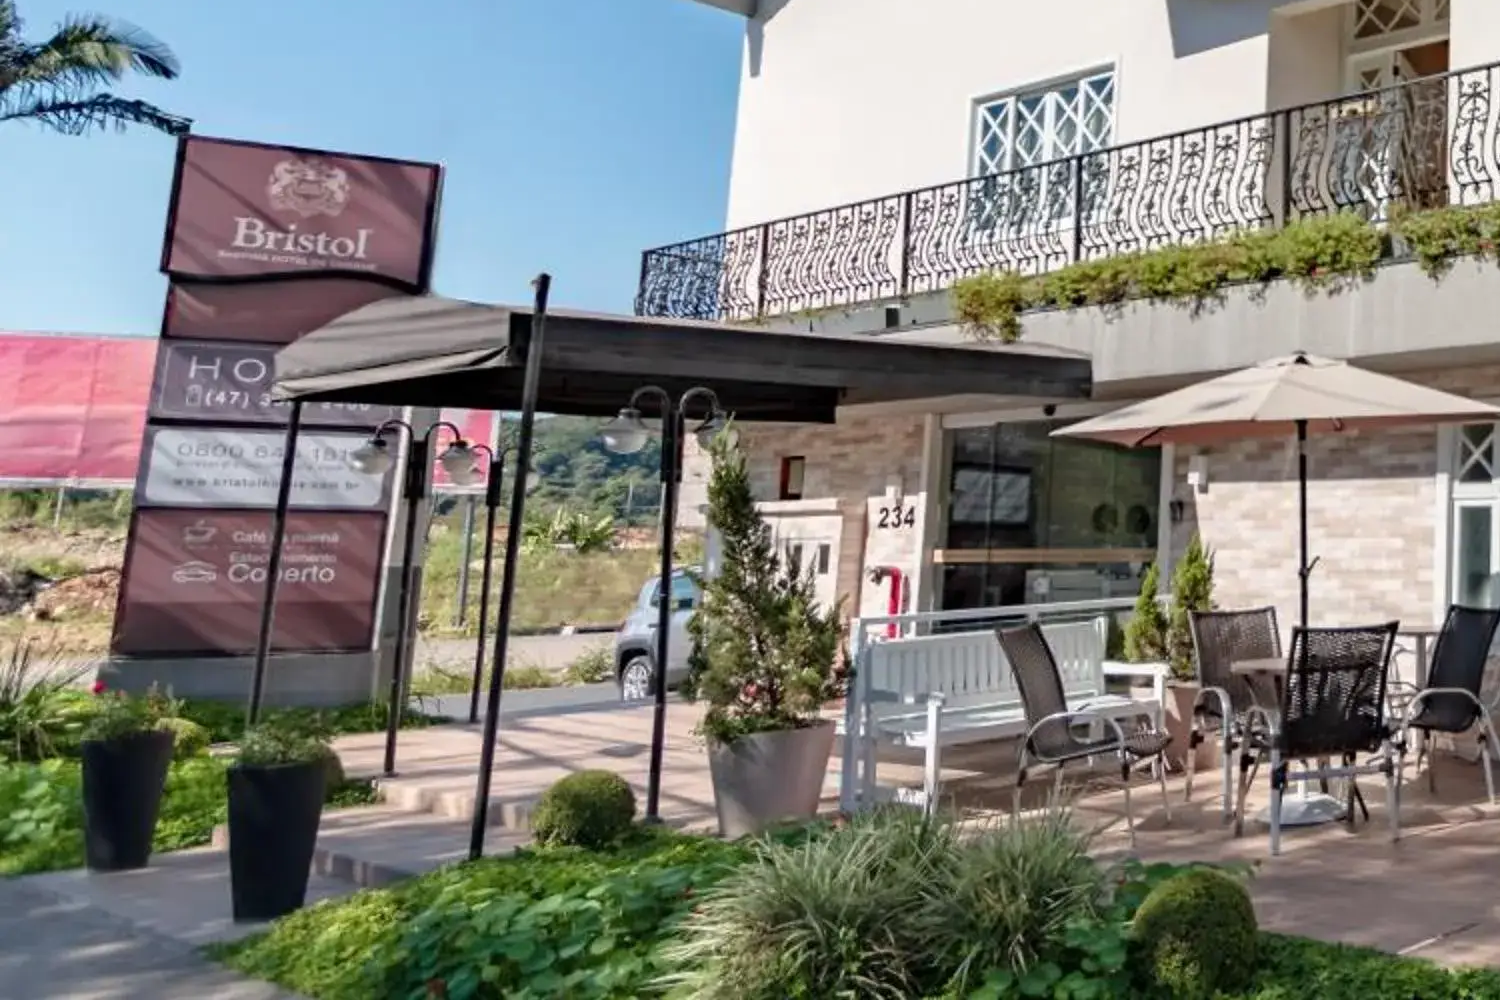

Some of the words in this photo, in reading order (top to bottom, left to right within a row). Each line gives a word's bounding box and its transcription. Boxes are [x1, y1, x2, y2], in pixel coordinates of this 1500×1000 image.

[231, 216, 374, 259] Bristol
[188, 356, 267, 383] HO
[205, 391, 249, 409] (47)
[878, 506, 915, 528] 234
